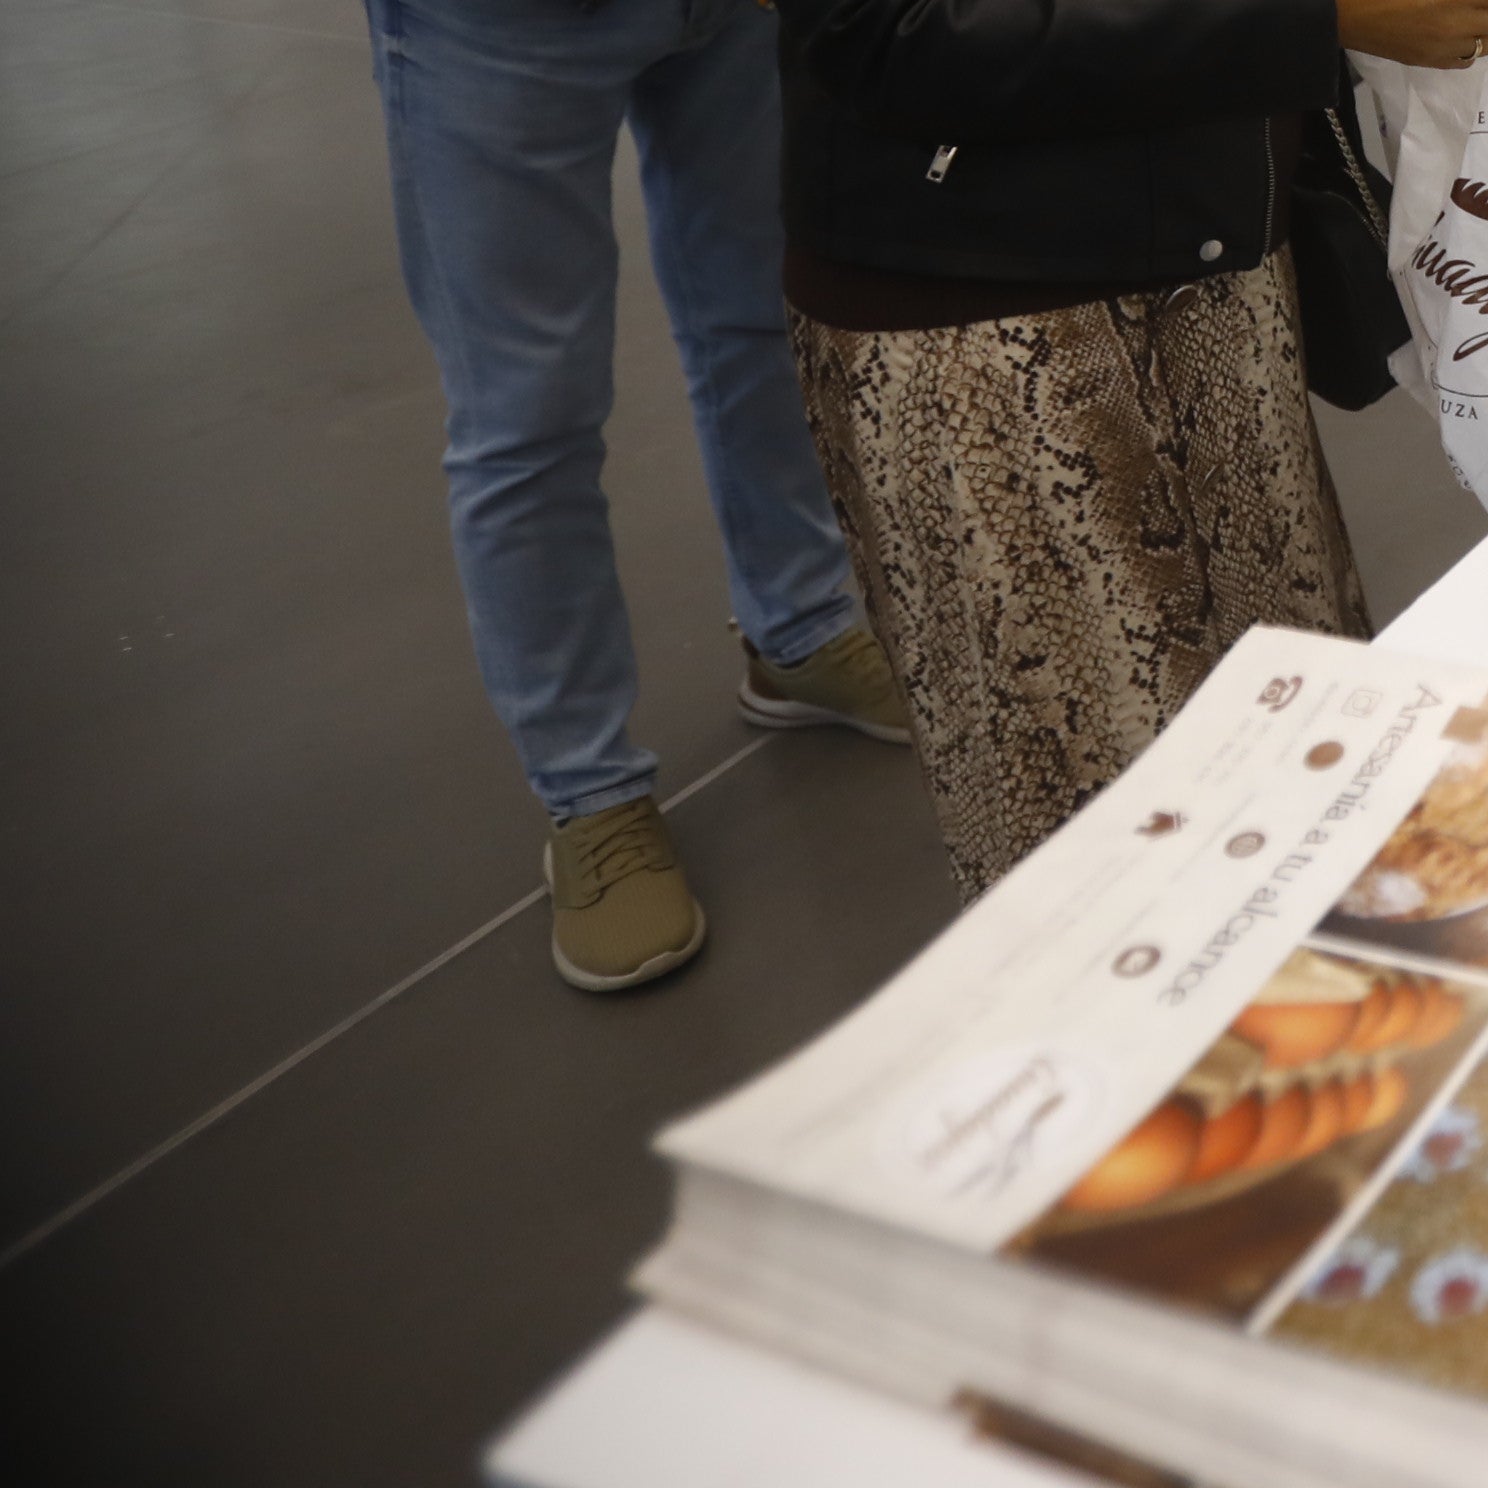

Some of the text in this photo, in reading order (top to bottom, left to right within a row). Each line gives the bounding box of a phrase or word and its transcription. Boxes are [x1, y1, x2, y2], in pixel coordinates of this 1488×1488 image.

[1325, 682, 1443, 823] Artesanía
[1272, 851, 1314, 882] tu
[1304, 826, 1329, 847] a
[1156, 885, 1279, 1008] alcance
